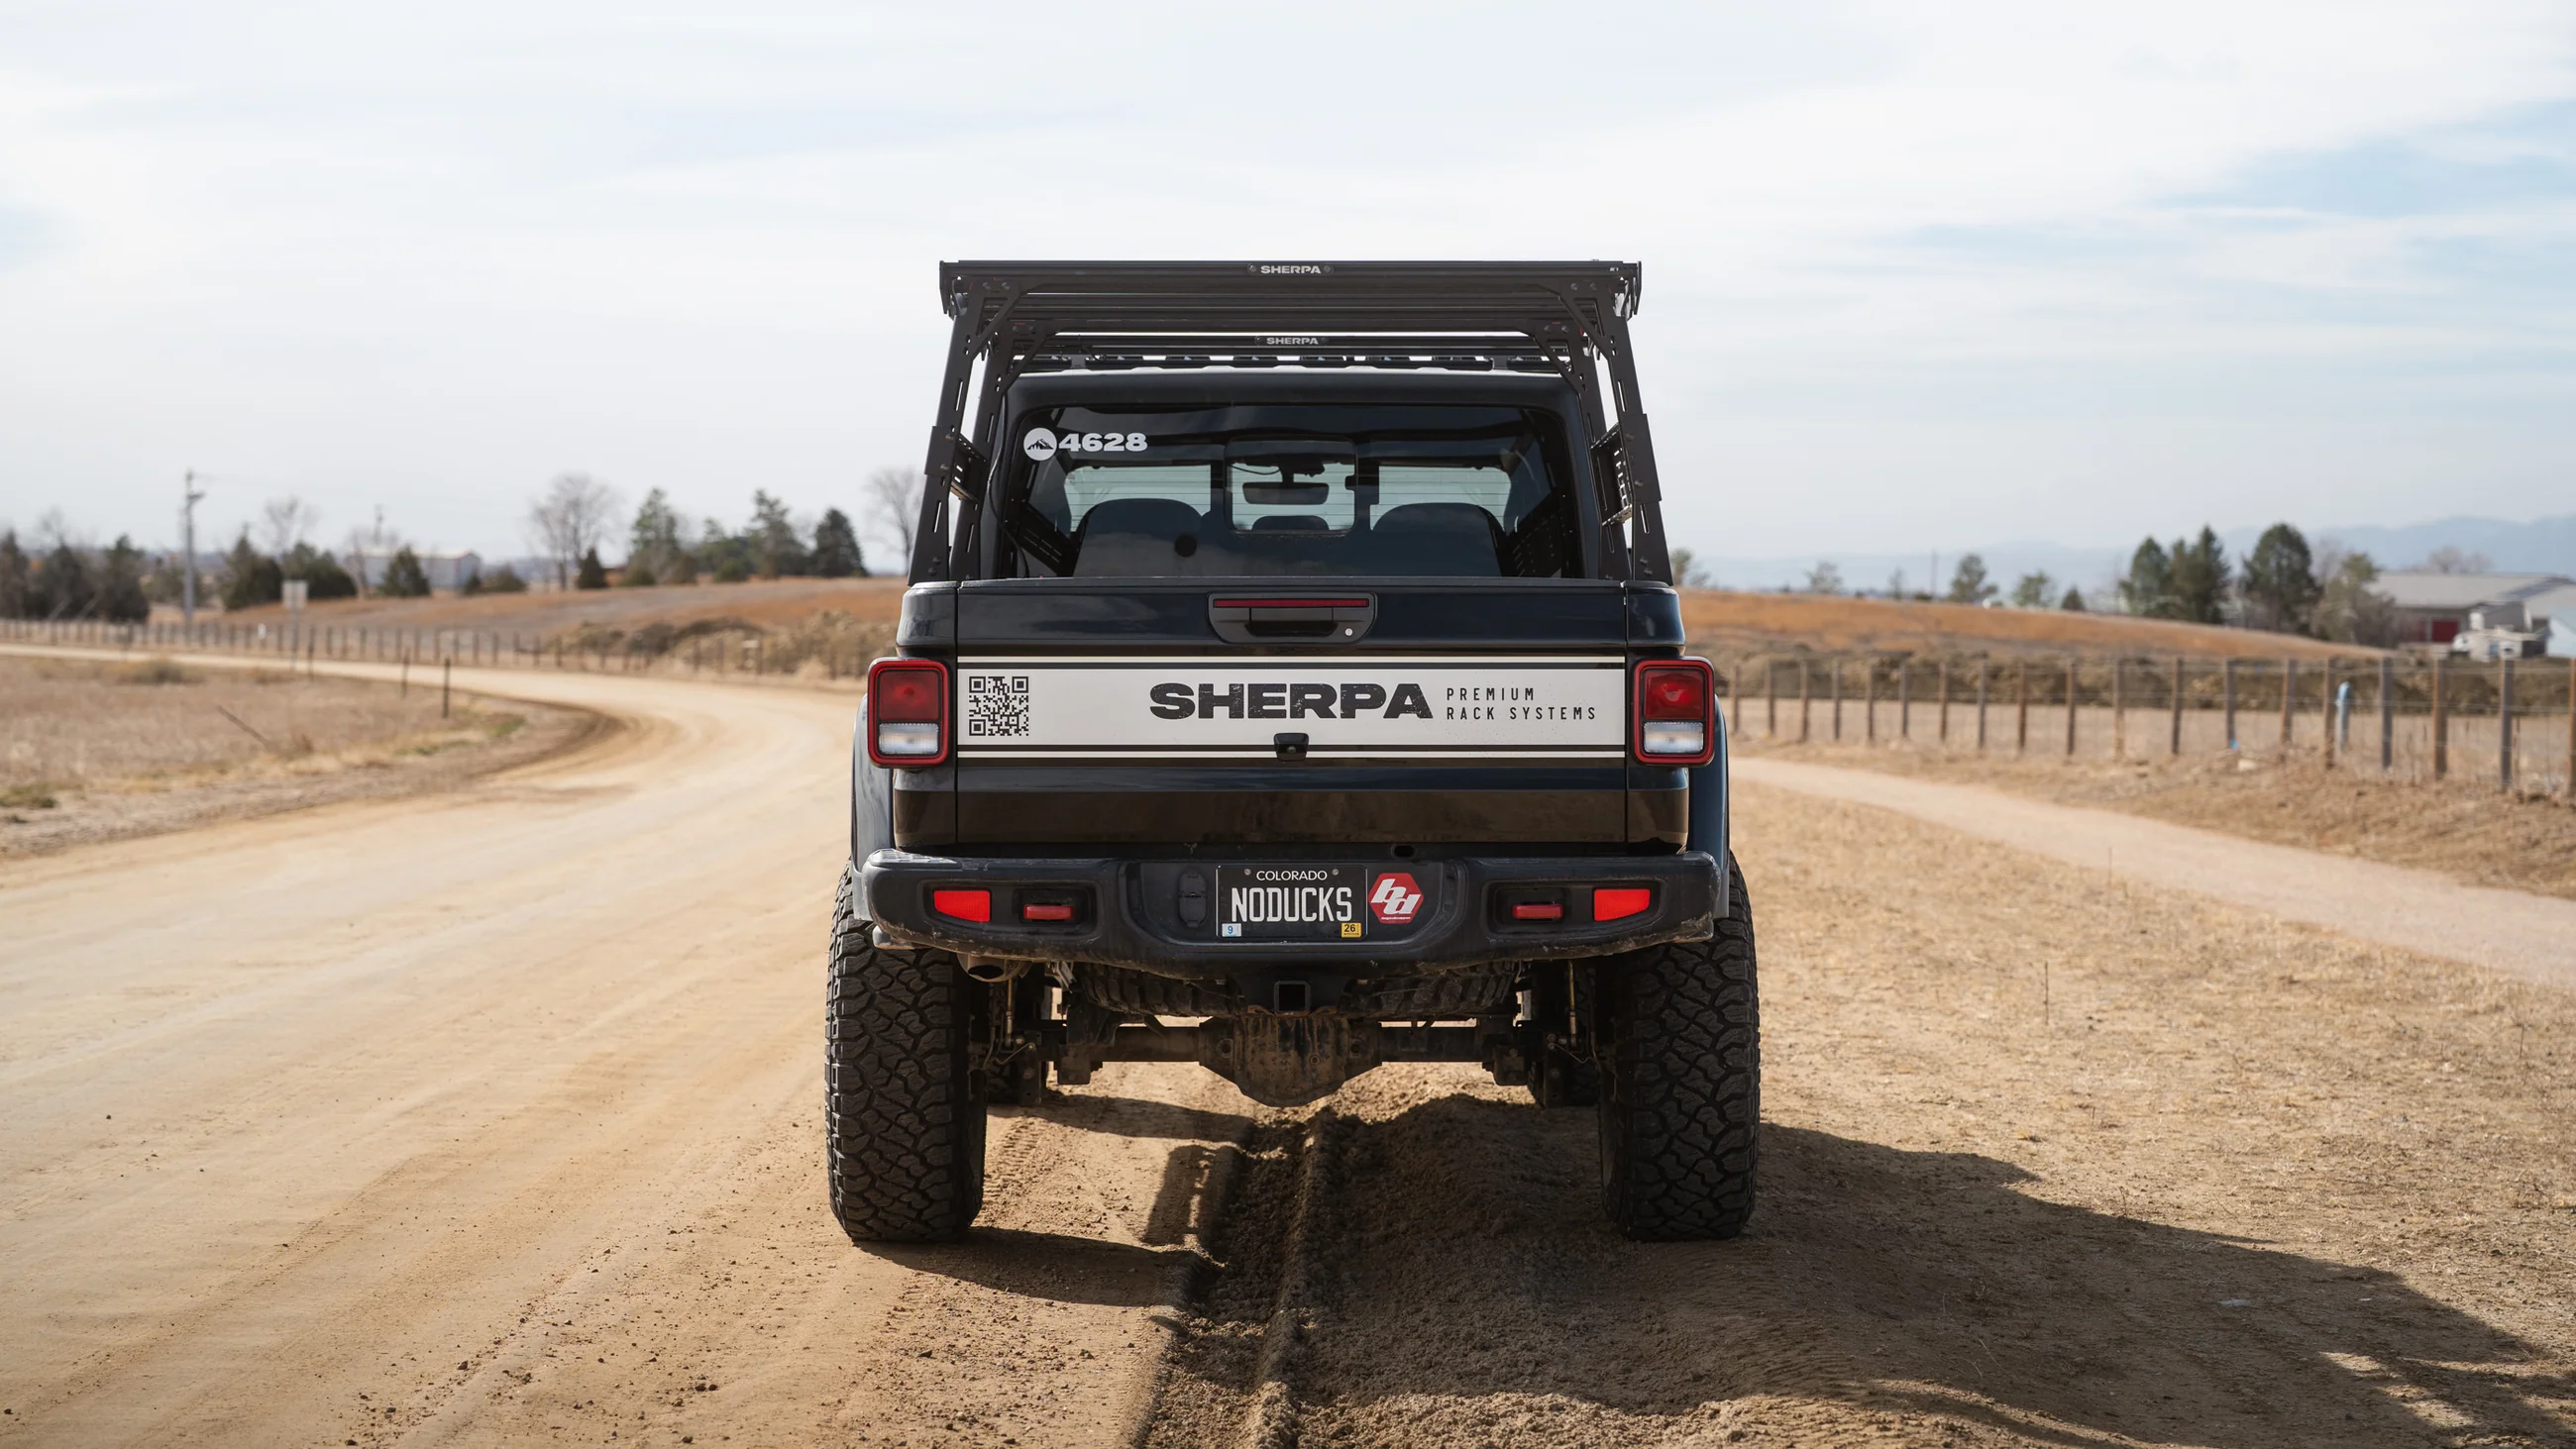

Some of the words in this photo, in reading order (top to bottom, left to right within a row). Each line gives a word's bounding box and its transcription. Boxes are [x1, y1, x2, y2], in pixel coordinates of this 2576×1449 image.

[1260, 264, 1322, 274] SHERPA
[1266, 337, 1319, 346] SHERPA
[1058, 432, 1148, 452] 4628
[1446, 687, 1535, 701] PREMIUM
[1149, 682, 1434, 720] SHERPA
[1446, 707, 1496, 720] RACK
[1509, 707, 1597, 720] SYSTEMS
[1256, 871, 1328, 881] COLORADO
[1232, 887, 1352, 922] NODUCKS
[1228, 925, 1234, 935] 9
[1343, 923, 1356, 933] 26
